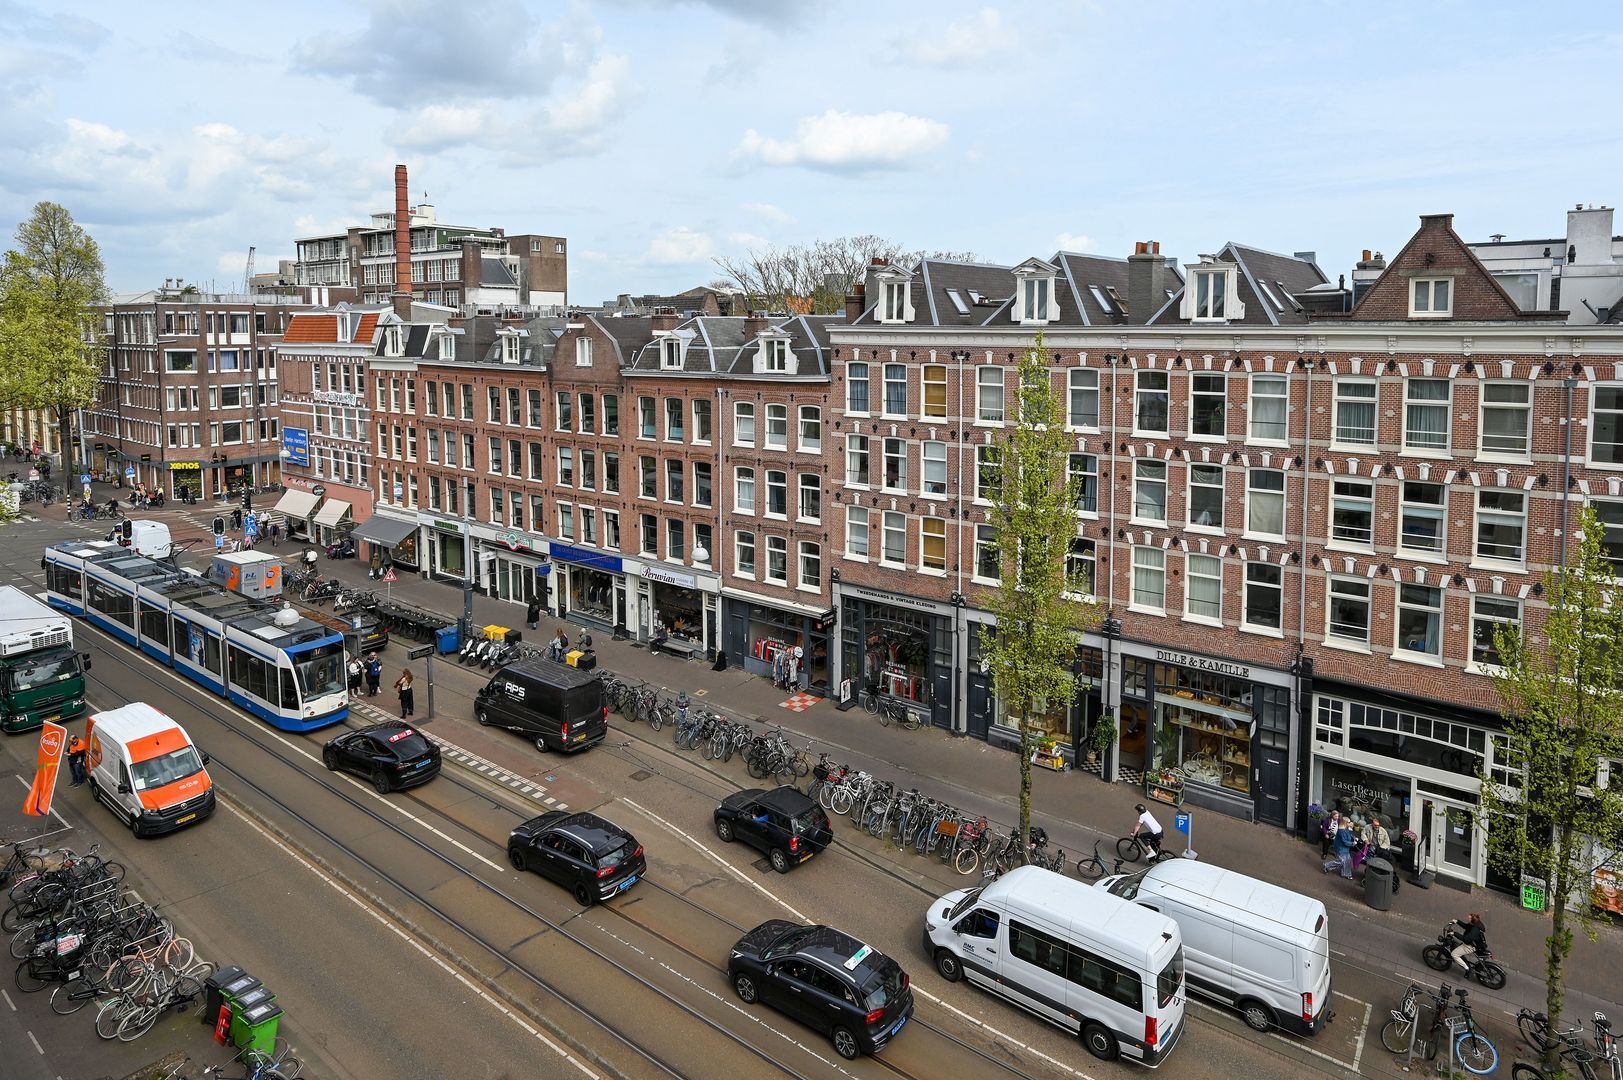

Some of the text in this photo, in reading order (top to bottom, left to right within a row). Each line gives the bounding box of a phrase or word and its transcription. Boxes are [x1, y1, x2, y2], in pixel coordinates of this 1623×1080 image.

[642, 566, 676, 584] Peruvian
[856, 589, 889, 600] TWEEDEHANDS
[916, 601, 936, 609] KLEDING
[1156, 650, 1250, 677] DILLE & KAMILLE
[505, 682, 526, 697] APS
[1331, 778, 1392, 801] LaserBeauty
